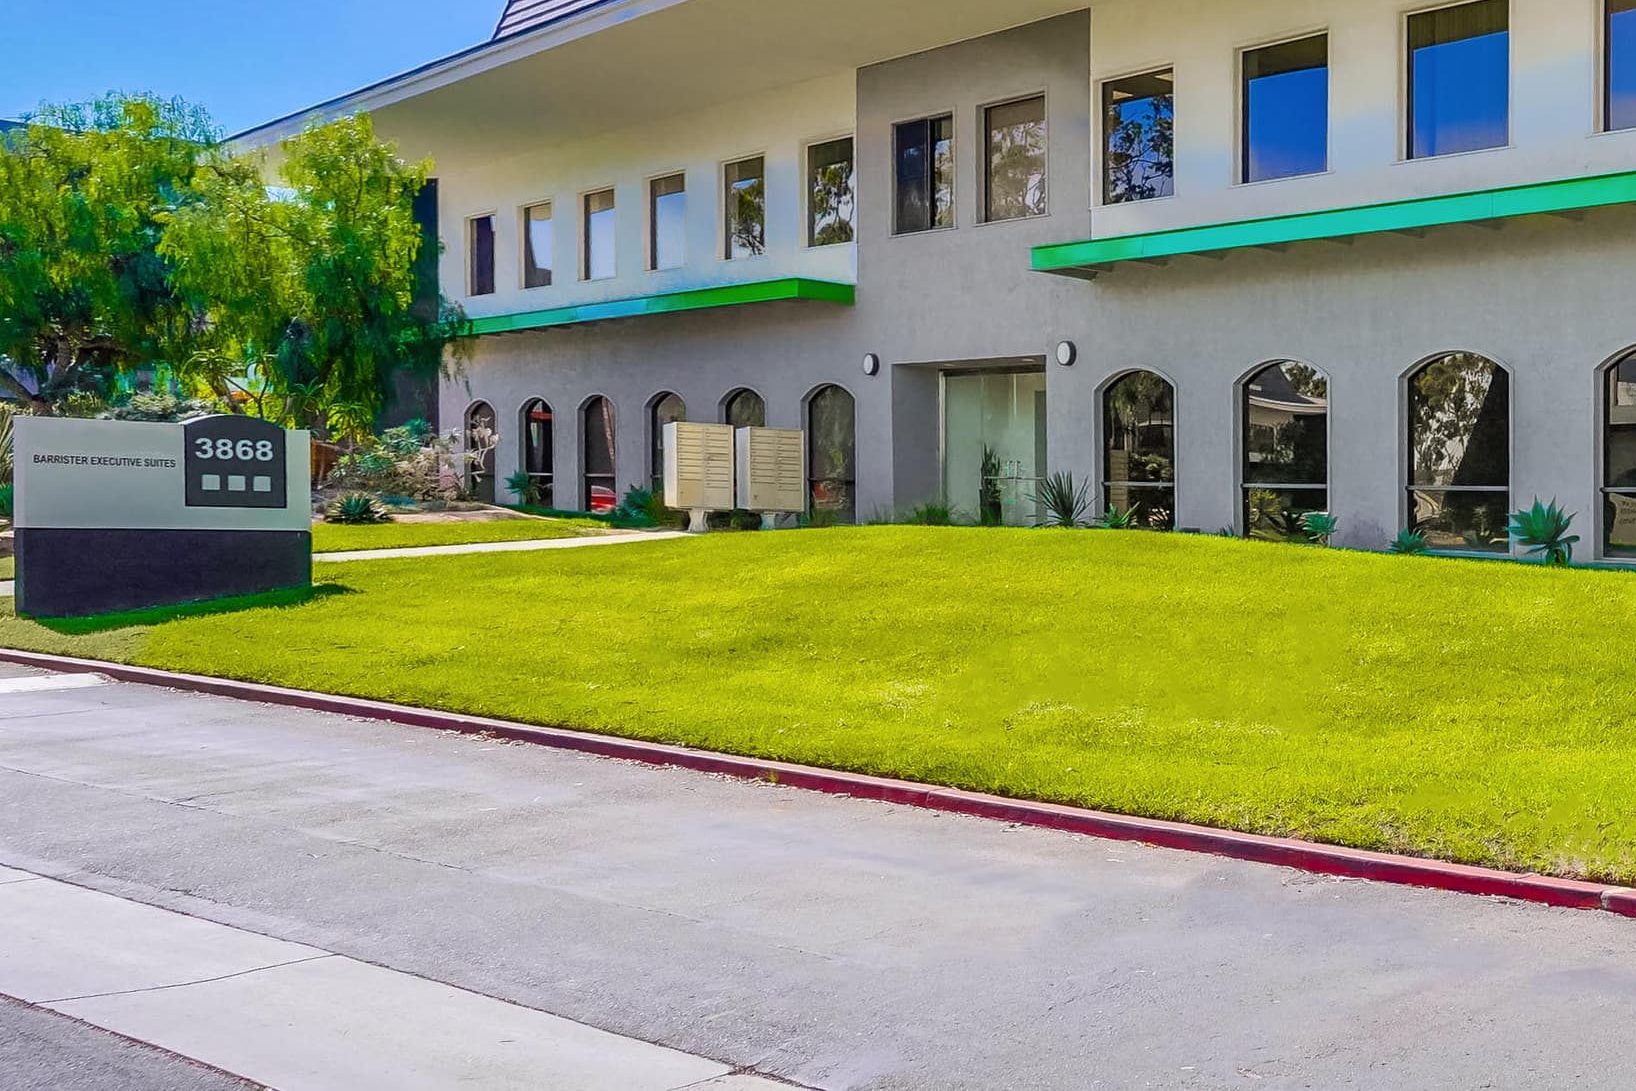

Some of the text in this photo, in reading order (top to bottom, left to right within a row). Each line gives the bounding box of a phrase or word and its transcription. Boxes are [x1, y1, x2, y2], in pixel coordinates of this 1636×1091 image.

[195, 437, 273, 461] 3868
[33, 454, 176, 468] BARRISTER EXECUTIVE SUITES
